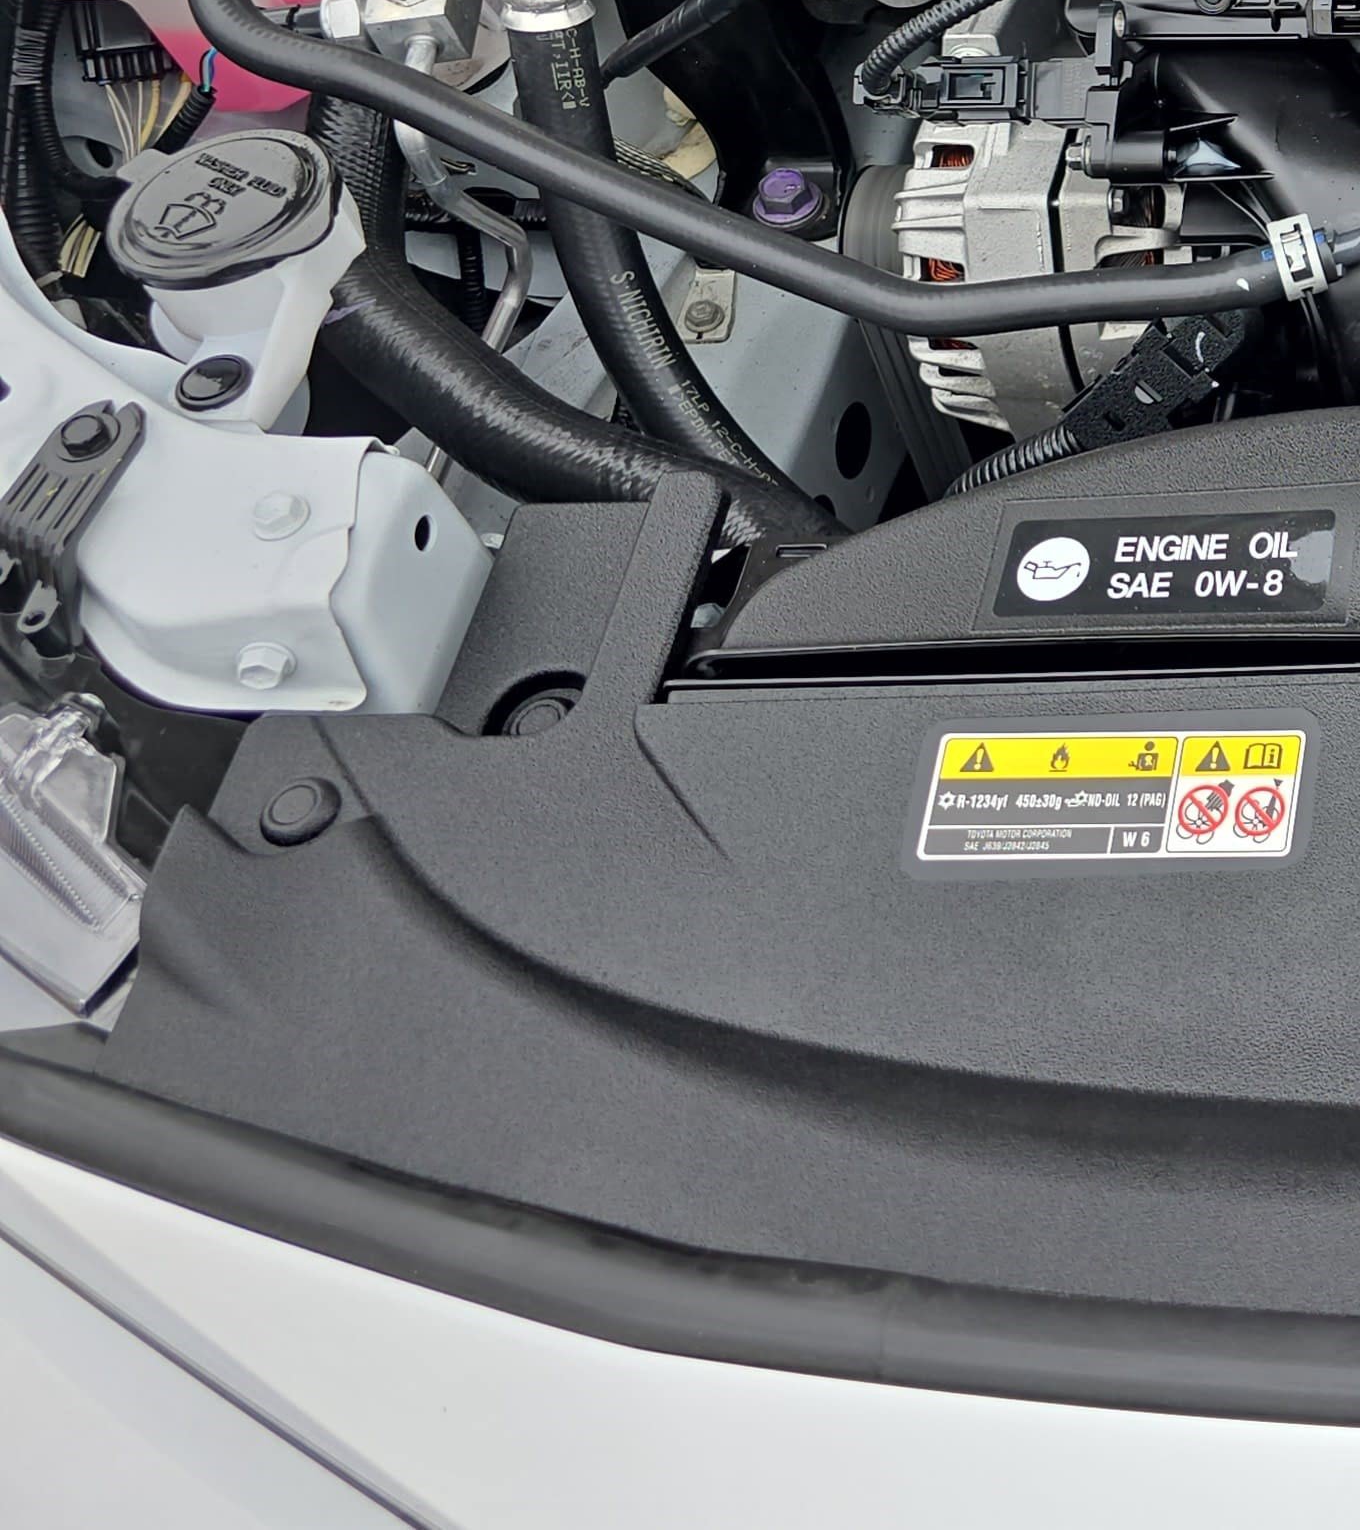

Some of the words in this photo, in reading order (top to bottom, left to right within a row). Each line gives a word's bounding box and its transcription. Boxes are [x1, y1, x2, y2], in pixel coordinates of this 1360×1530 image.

[1114, 533, 1230, 563] ENGINE
[1248, 531, 1298, 560] OIL
[1106, 571, 1173, 600] SAE
[1194, 569, 1284, 598] 0W-8
[1016, 793, 1062, 810] 450±30g
[1127, 792, 1137, 807] 12
[1140, 792, 1167, 808] (PAG)
[964, 842, 979, 852] SAE
[967, 829, 994, 839] TOYOTA
[996, 828, 1021, 839] MOTOR
[1023, 828, 1073, 839] CORPORATION
[1123, 831, 1138, 848] W
[1141, 831, 1151, 847] 6
